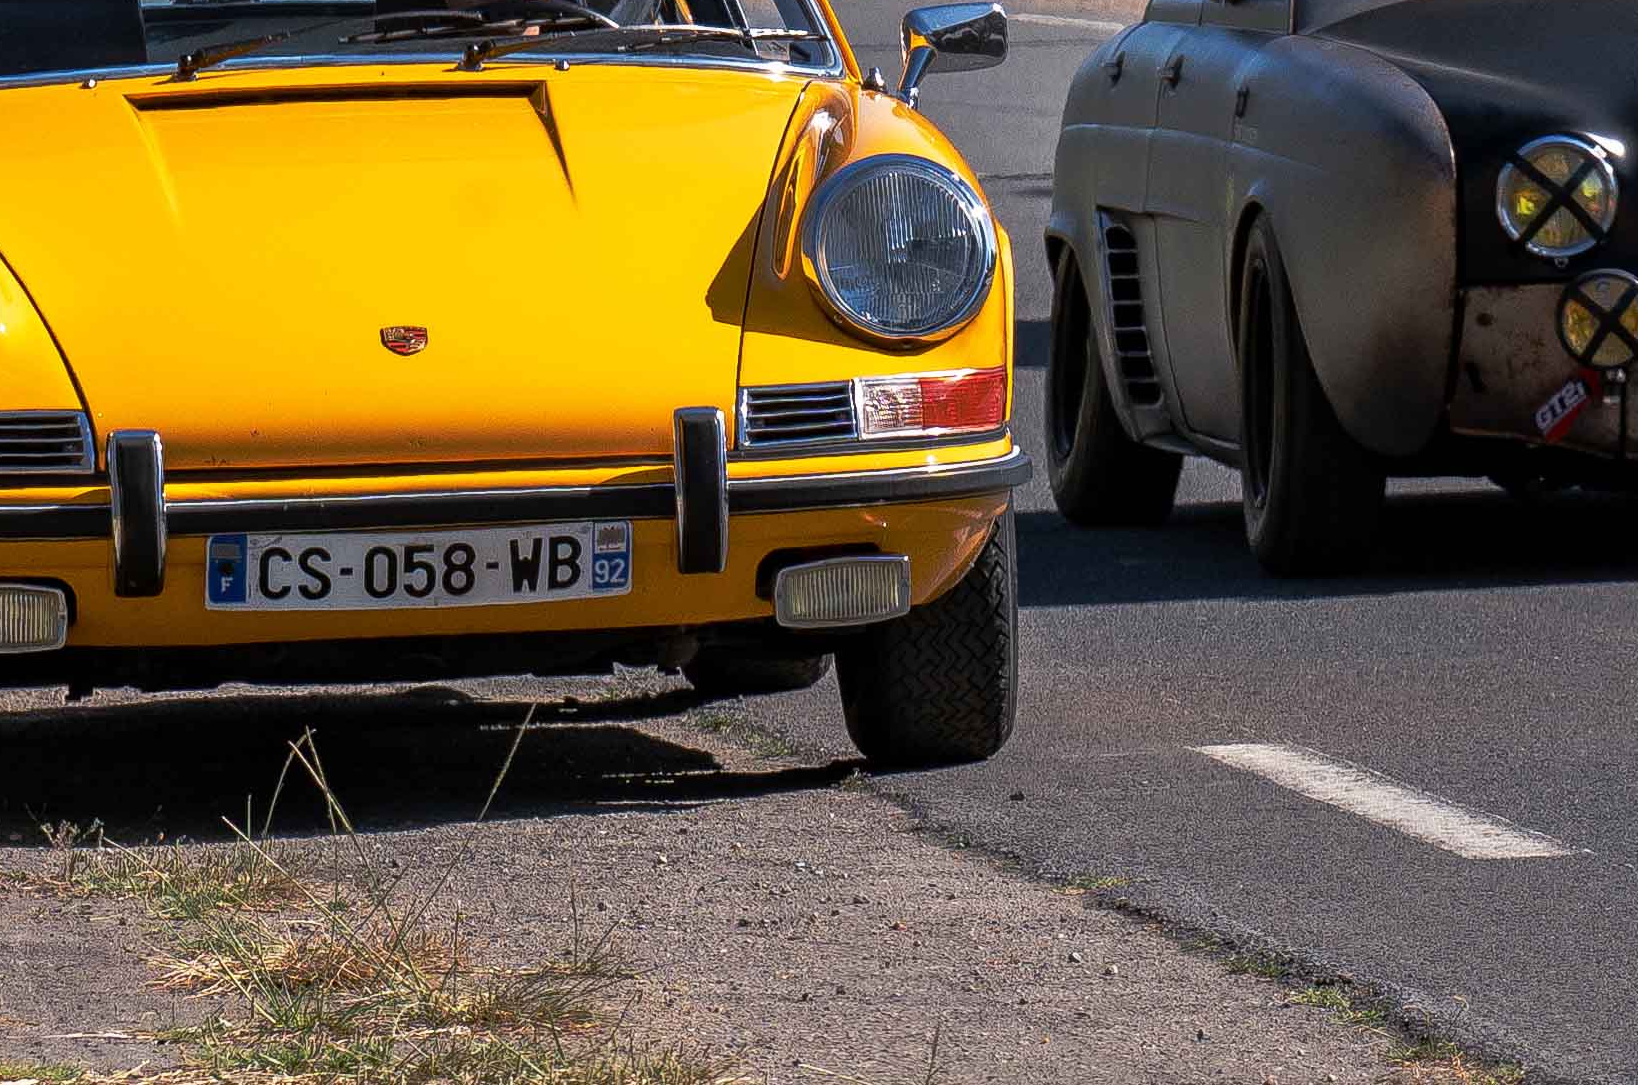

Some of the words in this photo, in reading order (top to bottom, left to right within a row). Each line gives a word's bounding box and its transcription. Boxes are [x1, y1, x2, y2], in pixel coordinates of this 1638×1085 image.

[258, 535, 582, 600] CS-058-WB
[595, 558, 626, 584] 92
[221, 576, 234, 593] F
